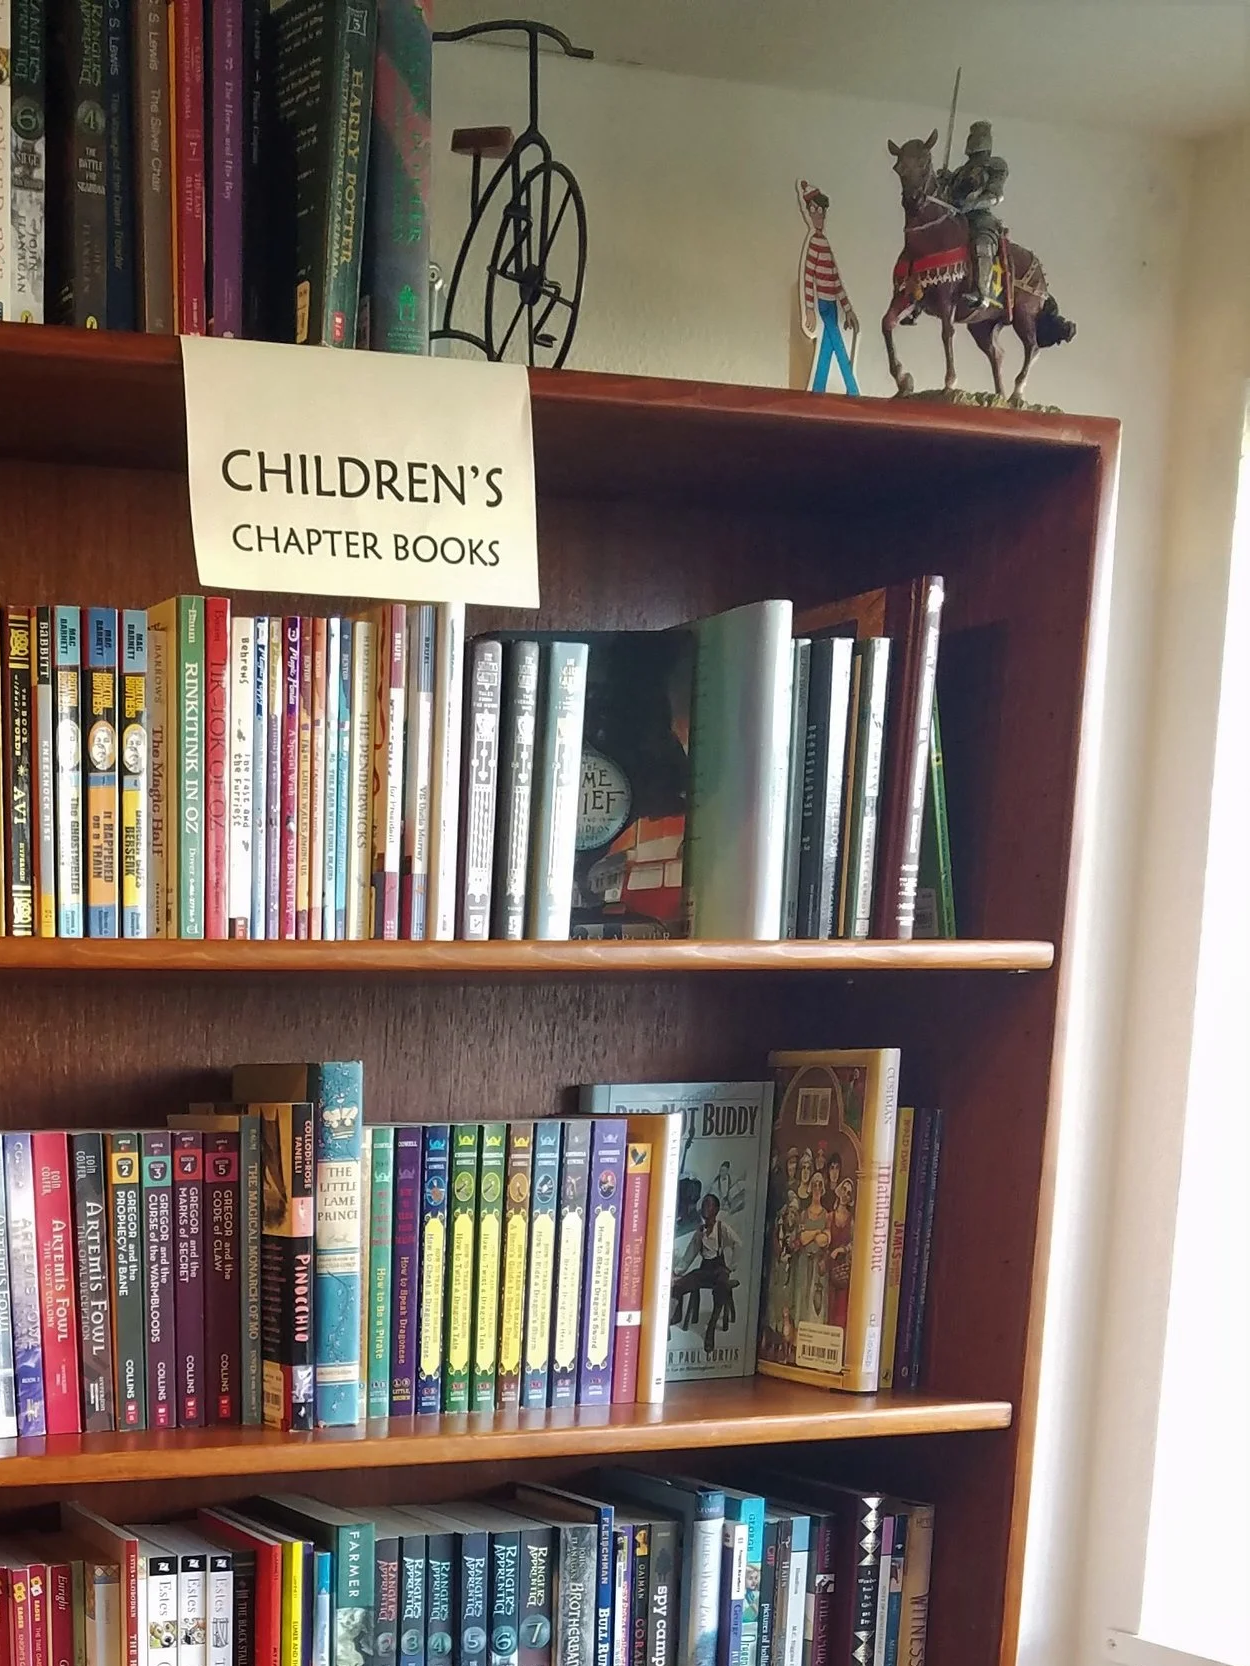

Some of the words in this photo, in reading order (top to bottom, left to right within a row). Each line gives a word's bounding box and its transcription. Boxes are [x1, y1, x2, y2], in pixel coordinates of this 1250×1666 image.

[350, 68, 364, 158] HARRY
[340, 172, 362, 265] POTTER
[221, 449, 504, 508] CHILDREN'S
[231, 523, 383, 560] CHAPTER
[393, 533, 501, 568] BOOKS
[185, 662, 198, 772] RINKITINK
[186, 780, 198, 800] IN
[13, 786, 27, 825] AVI
[186, 808, 198, 834] OZ
[702, 1103, 759, 1137] BUDDY
[184, 1162, 192, 1172] 4
[218, 1165, 226, 1175] 5
[295, 1137, 303, 1174] FANELLI
[319, 1181, 358, 1193] LITTLE
[326, 1166, 353, 1178] THE
[179, 1188, 188, 1226] MARKS
[190, 1187, 198, 1234] GREGOR
[213, 1191, 222, 1223] CODE
[224, 1190, 233, 1237] GREGOR
[317, 1211, 358, 1223] PRINCE
[323, 1196, 356, 1208] LAME
[179, 1229, 189, 1238] of
[214, 1226, 222, 1235] of
[179, 1242, 189, 1283] SECRET
[190, 1240, 199, 1258] and
[214, 1240, 222, 1272] CLAW
[224, 1243, 233, 1260] and
[190, 1260, 200, 1278] the
[225, 1263, 234, 1280] the
[294, 1254, 311, 1343] PINOCCHIO
[678, 1351, 702, 1364] PAUL
[706, 1348, 740, 1362] CURTIS
[349, 1531, 360, 1598] FARMER
[186, 1578, 200, 1614] Estes
[655, 1585, 668, 1614] spy
[598, 1608, 610, 1637] BULL
